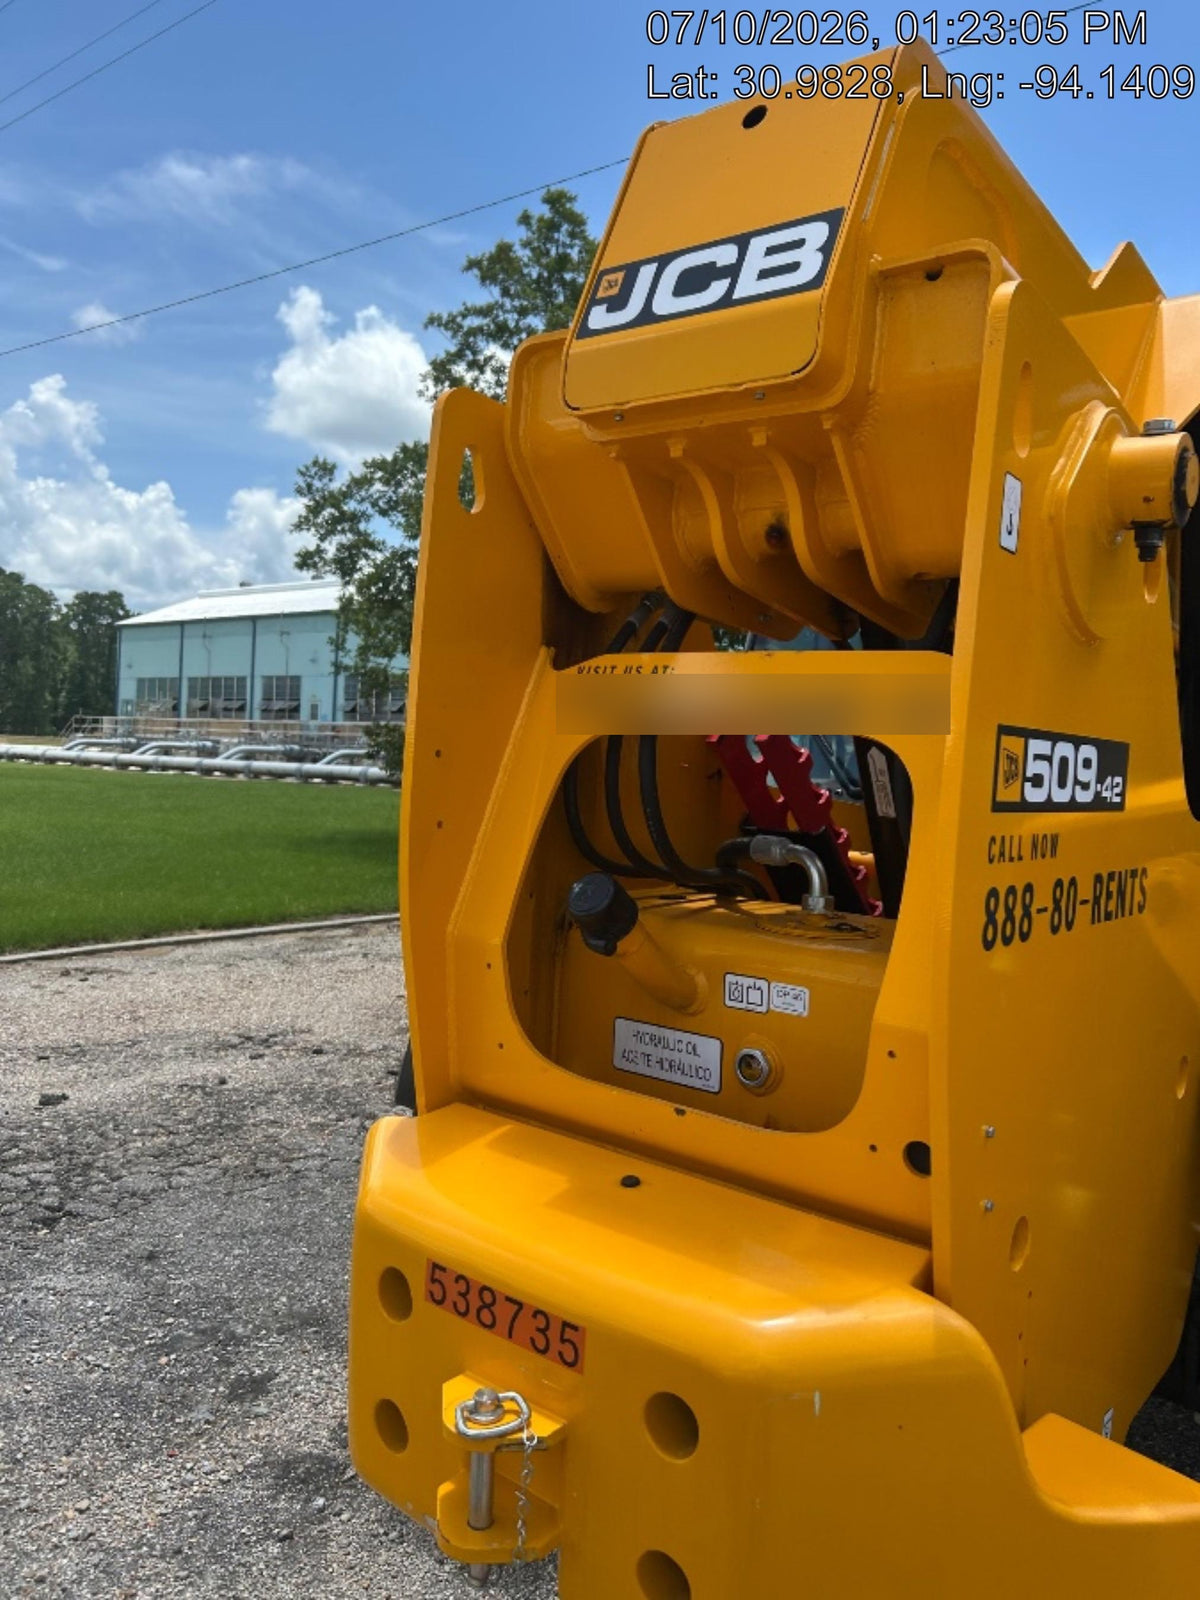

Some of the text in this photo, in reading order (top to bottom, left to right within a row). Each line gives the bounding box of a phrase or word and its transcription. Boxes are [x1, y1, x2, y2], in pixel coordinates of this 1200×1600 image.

[587, 221, 829, 330] JCB
[1024, 738, 1123, 803] 509-42
[988, 832, 1059, 864] CALL NOW
[982, 867, 1148, 952] 888-80-RENTS
[429, 1262, 579, 1368] 538735
